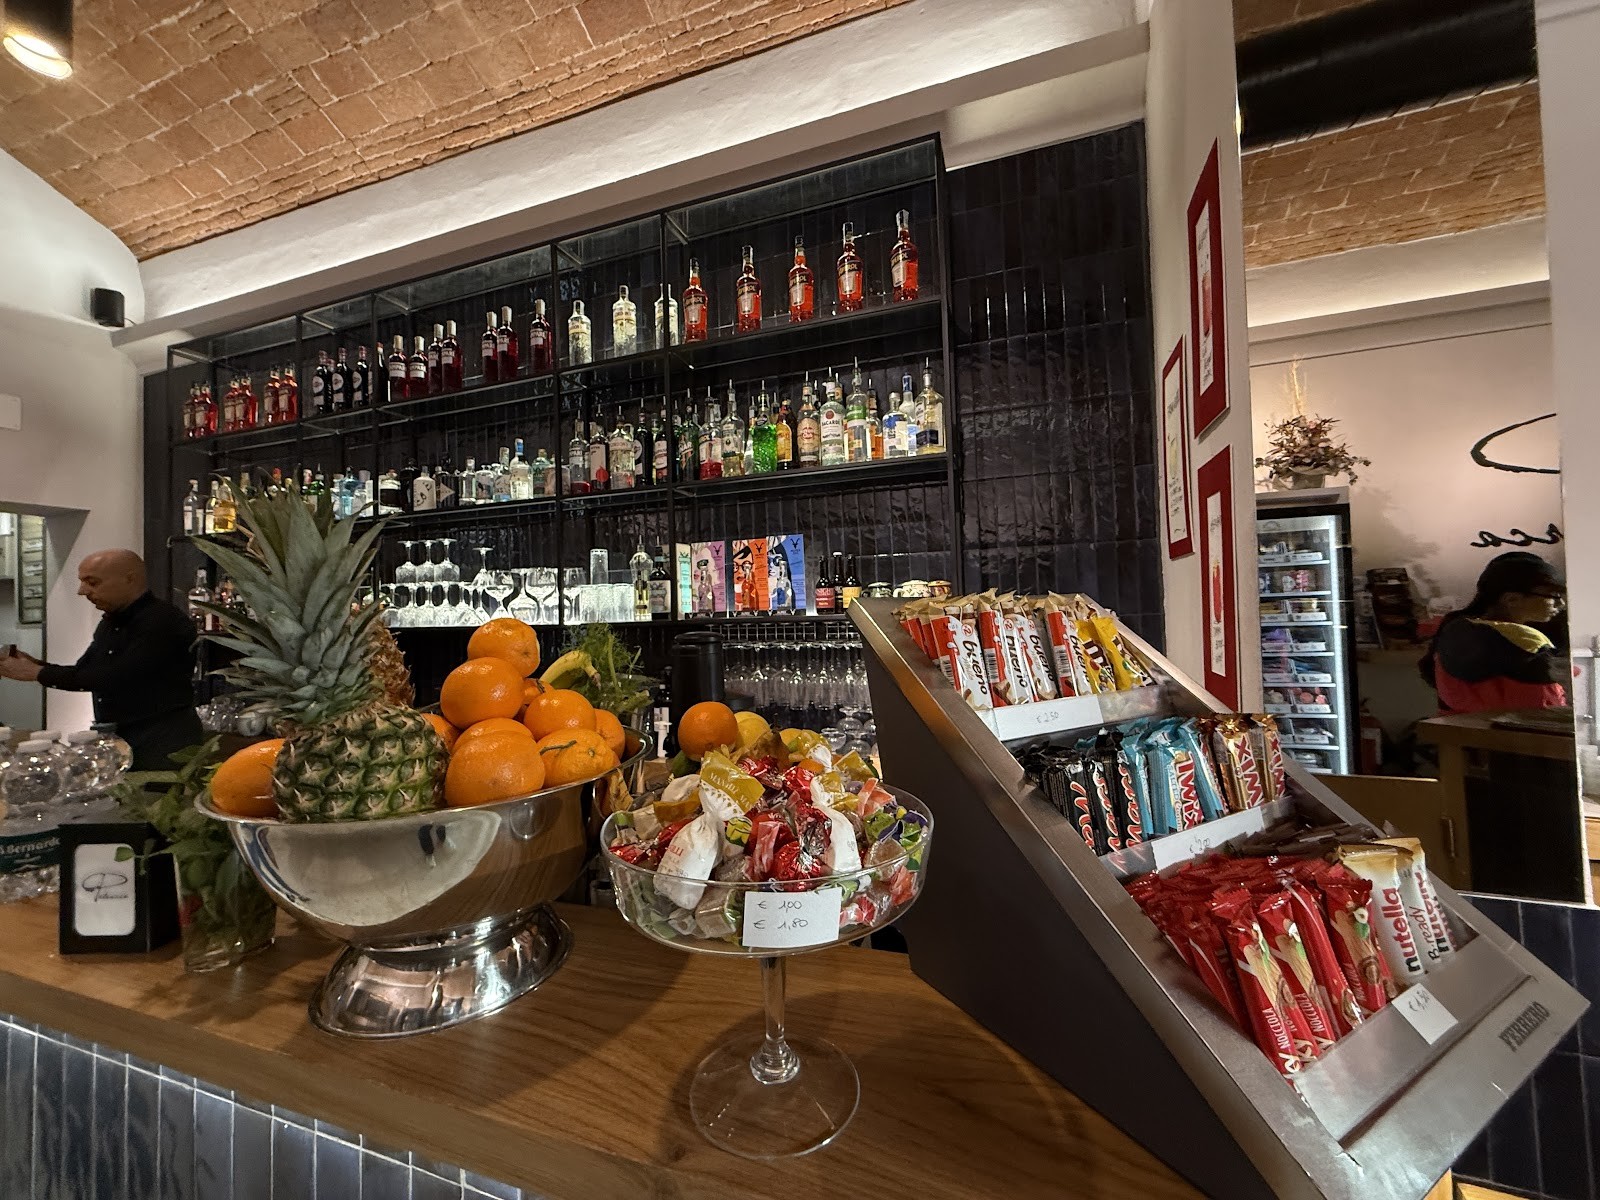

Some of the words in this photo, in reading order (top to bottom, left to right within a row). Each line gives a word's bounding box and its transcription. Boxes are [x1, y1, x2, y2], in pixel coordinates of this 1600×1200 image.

[962, 640, 988, 695] bueno
[1029, 634, 1057, 682] bueno
[1233, 733, 1264, 809] wix
[777, 918, 809, 930] 1,80
[778, 900, 803, 913] 1,00
[1381, 887, 1421, 973] nutella
[1408, 905, 1440, 960] B-ready
[1262, 1007, 1292, 1050] NOCCIOLA
[1295, 992, 1326, 1033] NOCCIOLA
[1498, 1001, 1551, 1053] FERRERO
